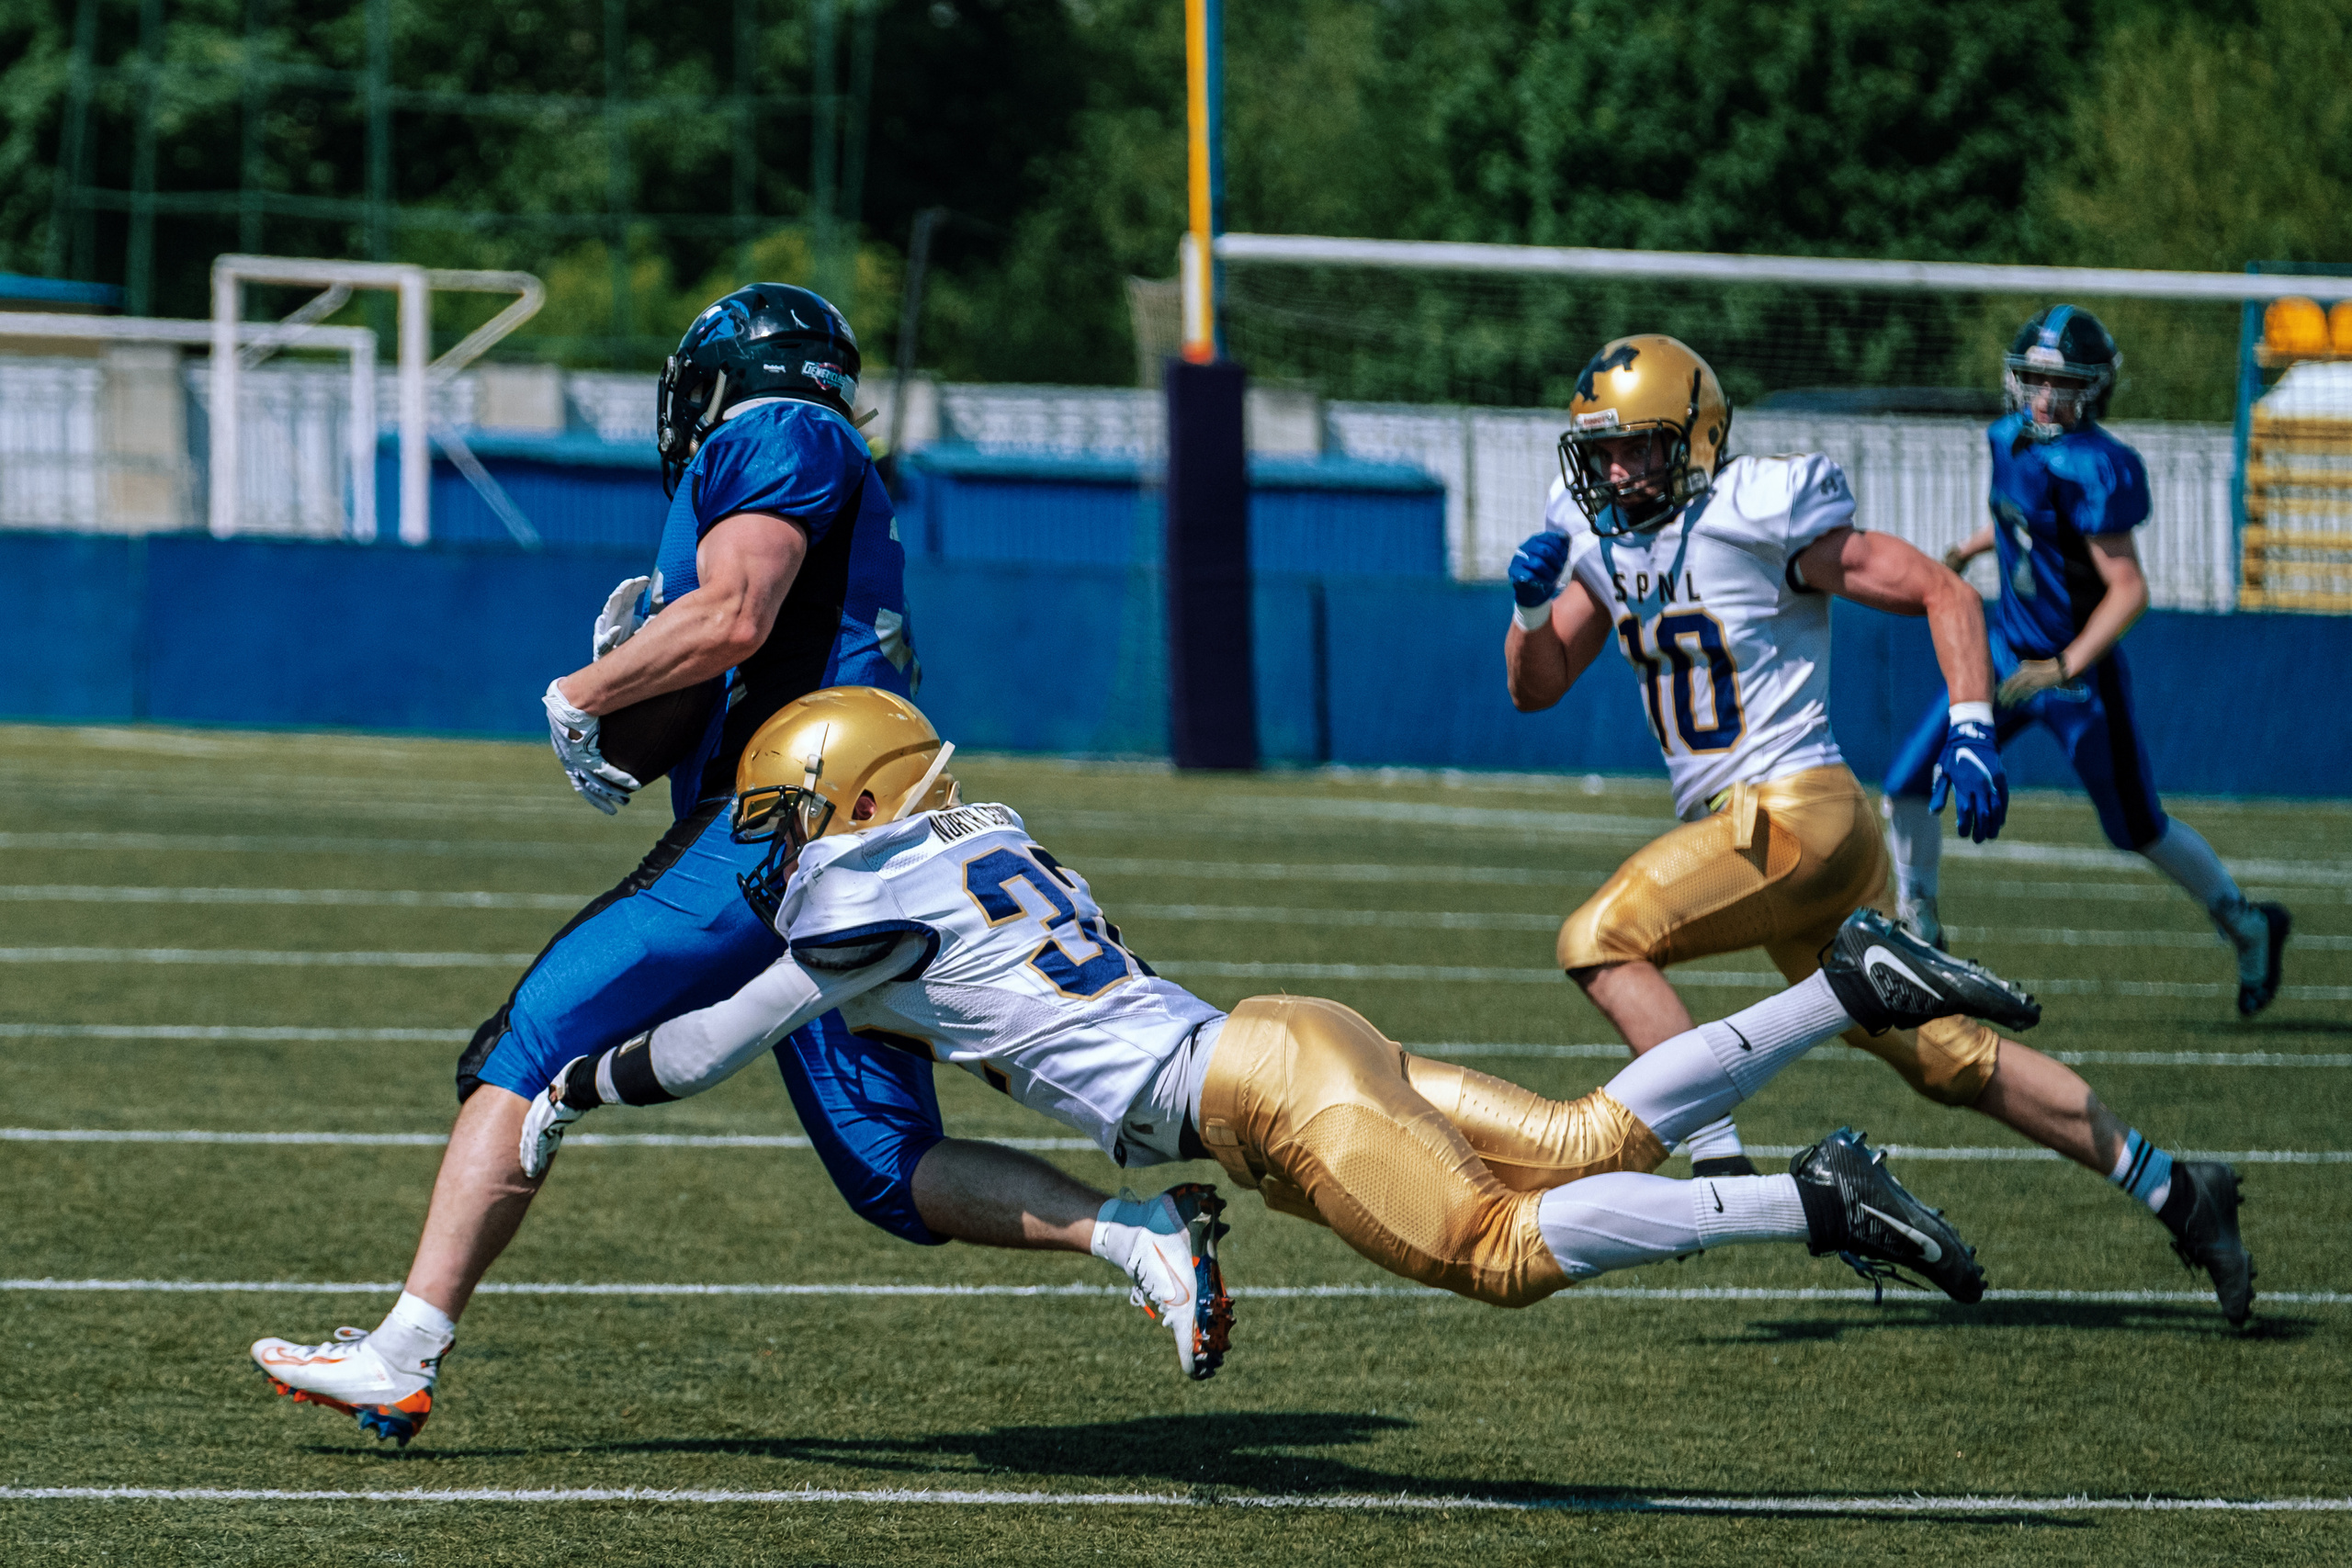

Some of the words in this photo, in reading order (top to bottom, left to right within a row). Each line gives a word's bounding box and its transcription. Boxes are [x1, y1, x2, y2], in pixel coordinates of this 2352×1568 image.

[1612, 568, 1702, 604] SPNL
[1617, 607, 1747, 756] 10
[928, 809, 989, 844] NORTH
